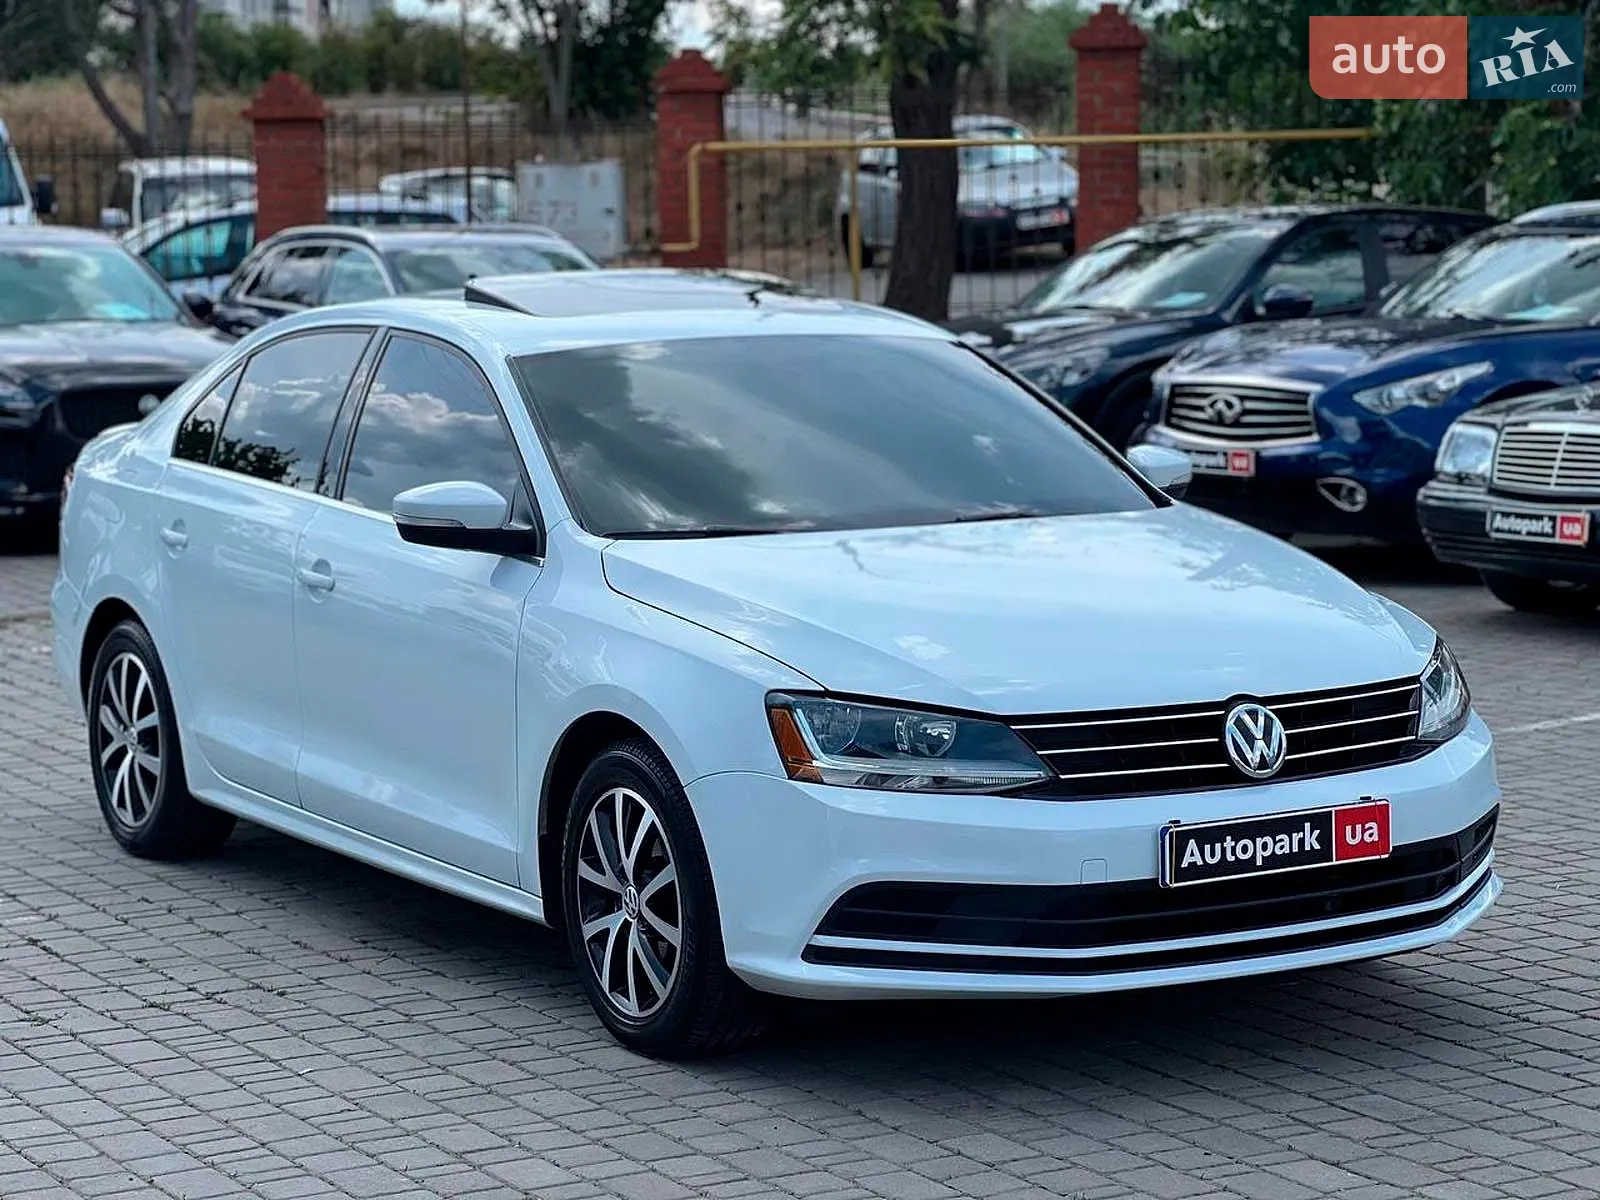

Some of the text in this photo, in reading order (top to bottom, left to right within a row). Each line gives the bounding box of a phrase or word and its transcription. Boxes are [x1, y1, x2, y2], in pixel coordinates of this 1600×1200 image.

[1492, 512, 1582, 537] Autopark ua
[1181, 821, 1379, 868] Autopark ua
